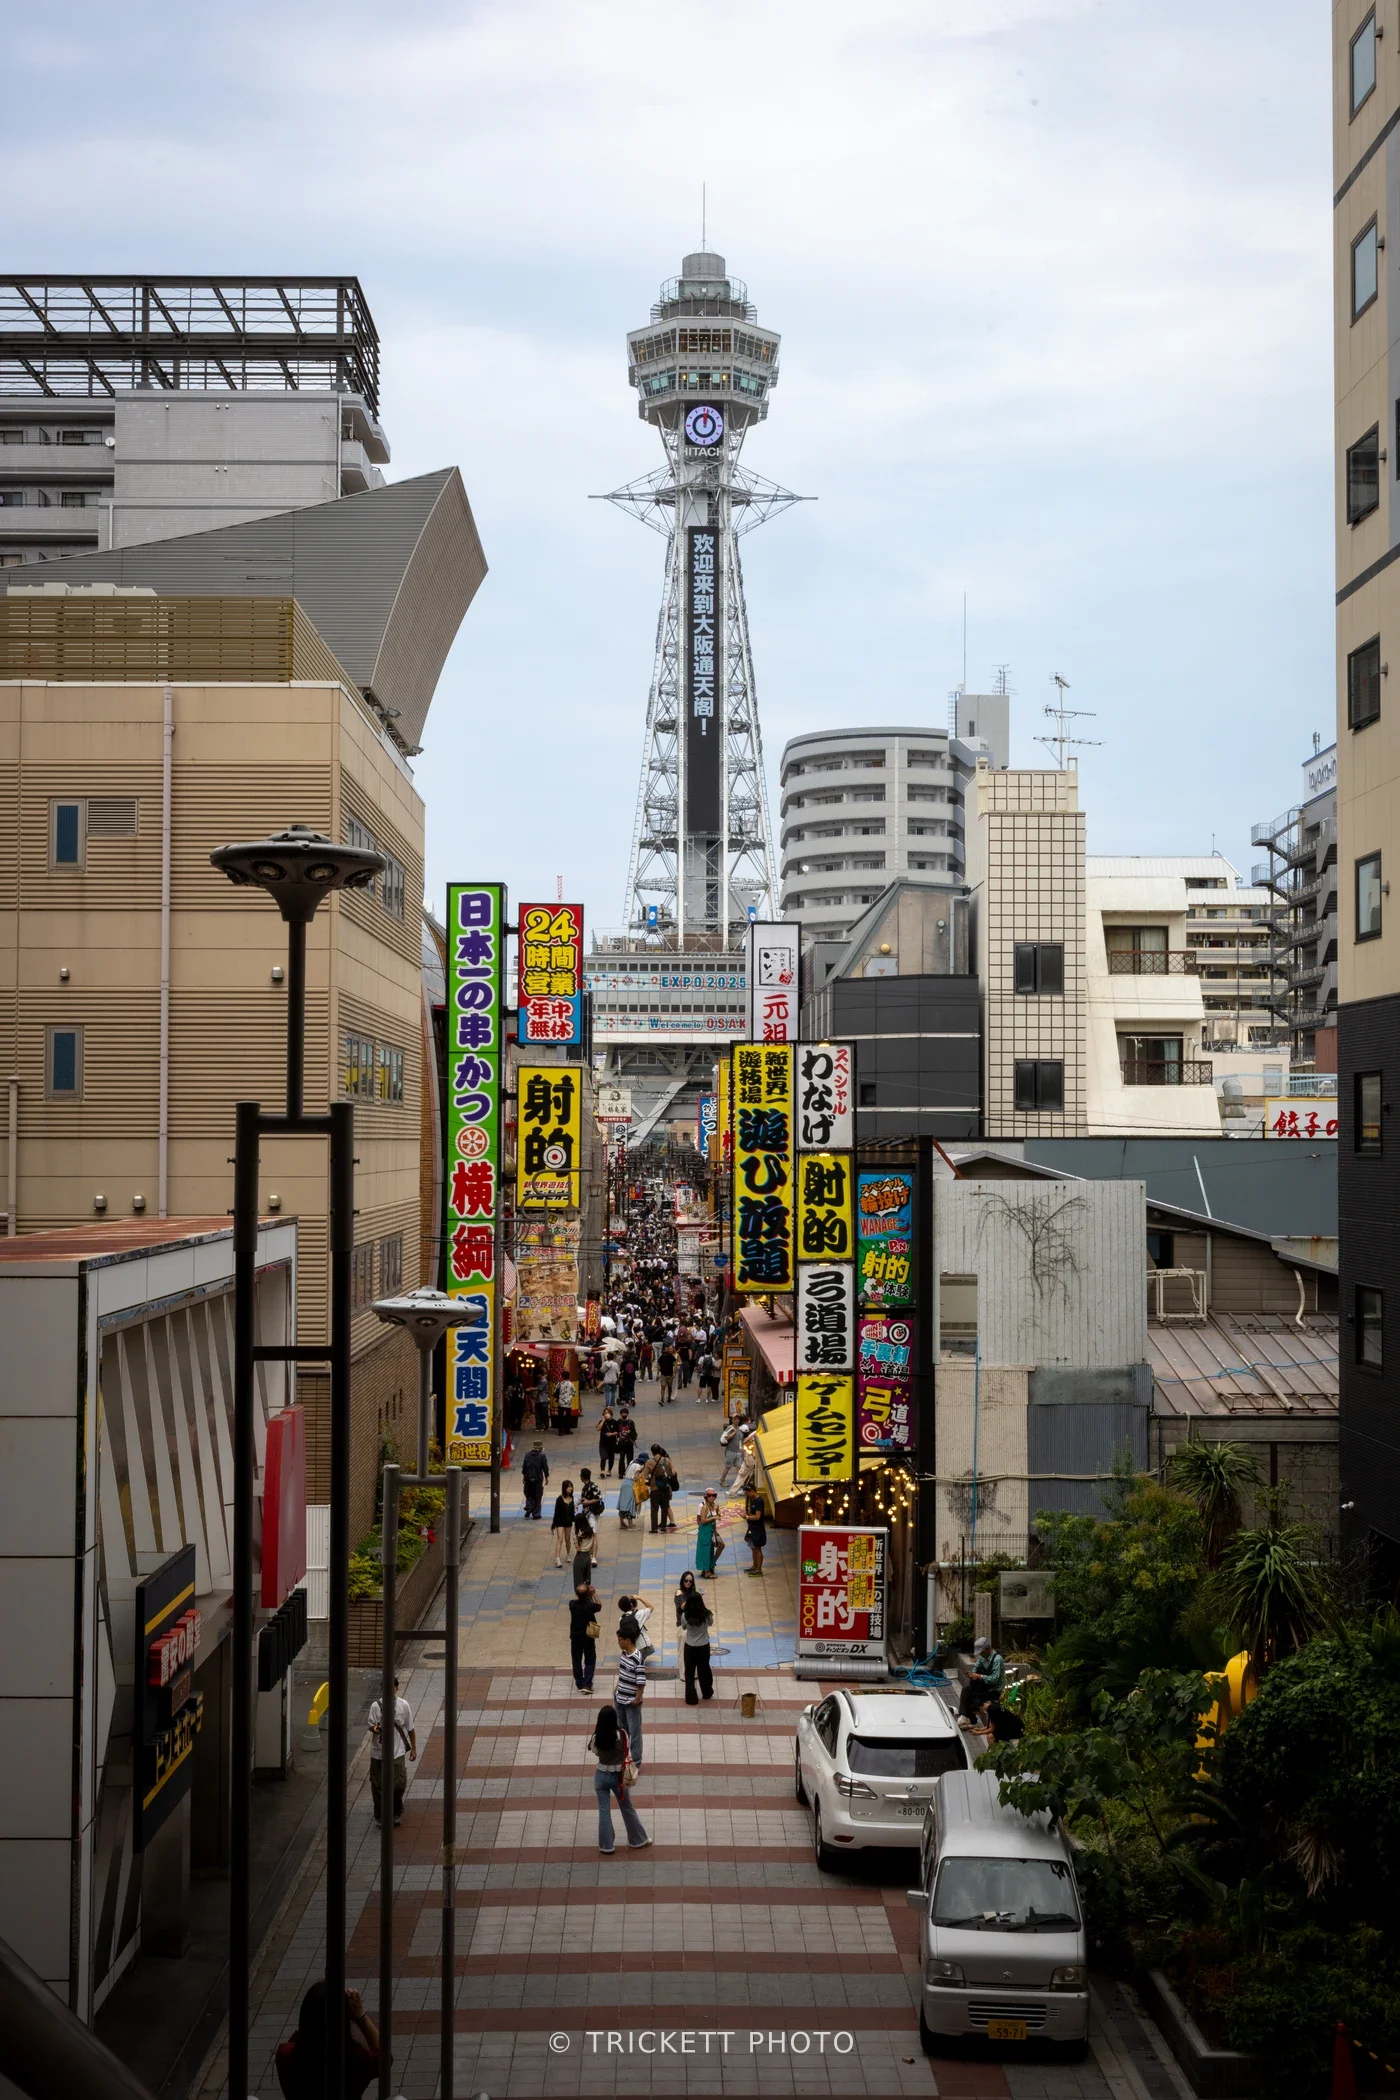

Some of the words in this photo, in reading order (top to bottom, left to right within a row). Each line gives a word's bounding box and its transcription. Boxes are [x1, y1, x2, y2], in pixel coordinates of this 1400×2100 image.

[526, 909, 576, 944] 24
[525, 943, 576, 969] 時間
[523, 971, 576, 997] 営業
[456, 891, 495, 1125] 日本一の串かつ
[527, 1000, 573, 1021] 年中
[527, 1020, 573, 1040] 無休
[801, 1050, 836, 1144] わなげ
[832, 1049, 849, 1115] スペシャル
[523, 1074, 575, 1177] 射的
[860, 1177, 903, 1194] スペシャル
[860, 1186, 910, 1213] 輪投げ
[452, 1160, 494, 1280] 横綱
[803, 1160, 848, 1254] 射的
[861, 1250, 910, 1284] 射的
[883, 1281, 910, 1299] 体験
[804, 1270, 848, 1365] 弓道場
[453, 1294, 491, 1439] 通天閣店
[859, 1340, 910, 1365] 手裏剣
[804, 1380, 848, 1476] ゲームセンター
[449, 1441, 492, 1461] 新世界
[816, 1541, 855, 1631] 射的
[850, 1644, 869, 1653] DX
